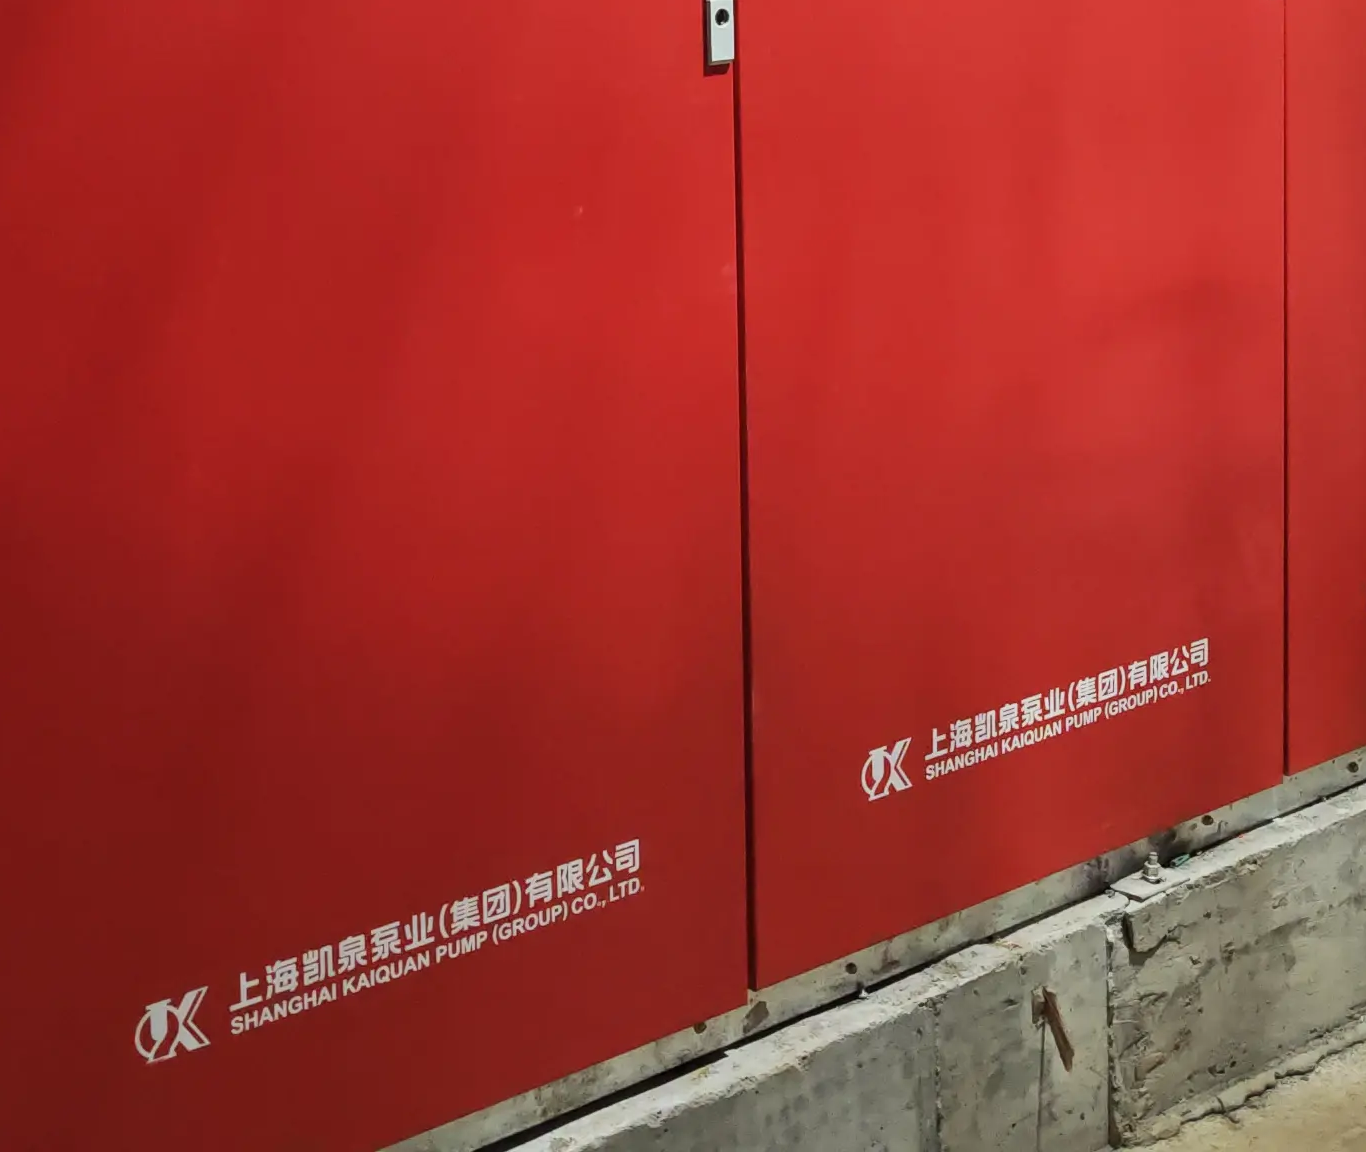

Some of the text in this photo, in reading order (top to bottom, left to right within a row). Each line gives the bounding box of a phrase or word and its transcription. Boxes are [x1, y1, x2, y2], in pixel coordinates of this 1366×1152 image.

[924, 637, 1209, 761] 上海凯泉泵业(集团)有限公司
[925, 741, 998, 781] SHANGHAI
[1001, 721, 1061, 754] KAIQUAN
[1065, 706, 1101, 732] PUMP
[1104, 686, 1158, 720] (GROUP)
[1185, 670, 1211, 690] LTD.
[229, 838, 640, 1013] 上海凯泉泵业(集团)有限公司
[230, 877, 645, 1036] SHANGHAI KAIQUAN PUMP (GROUP) CO., LTD.
